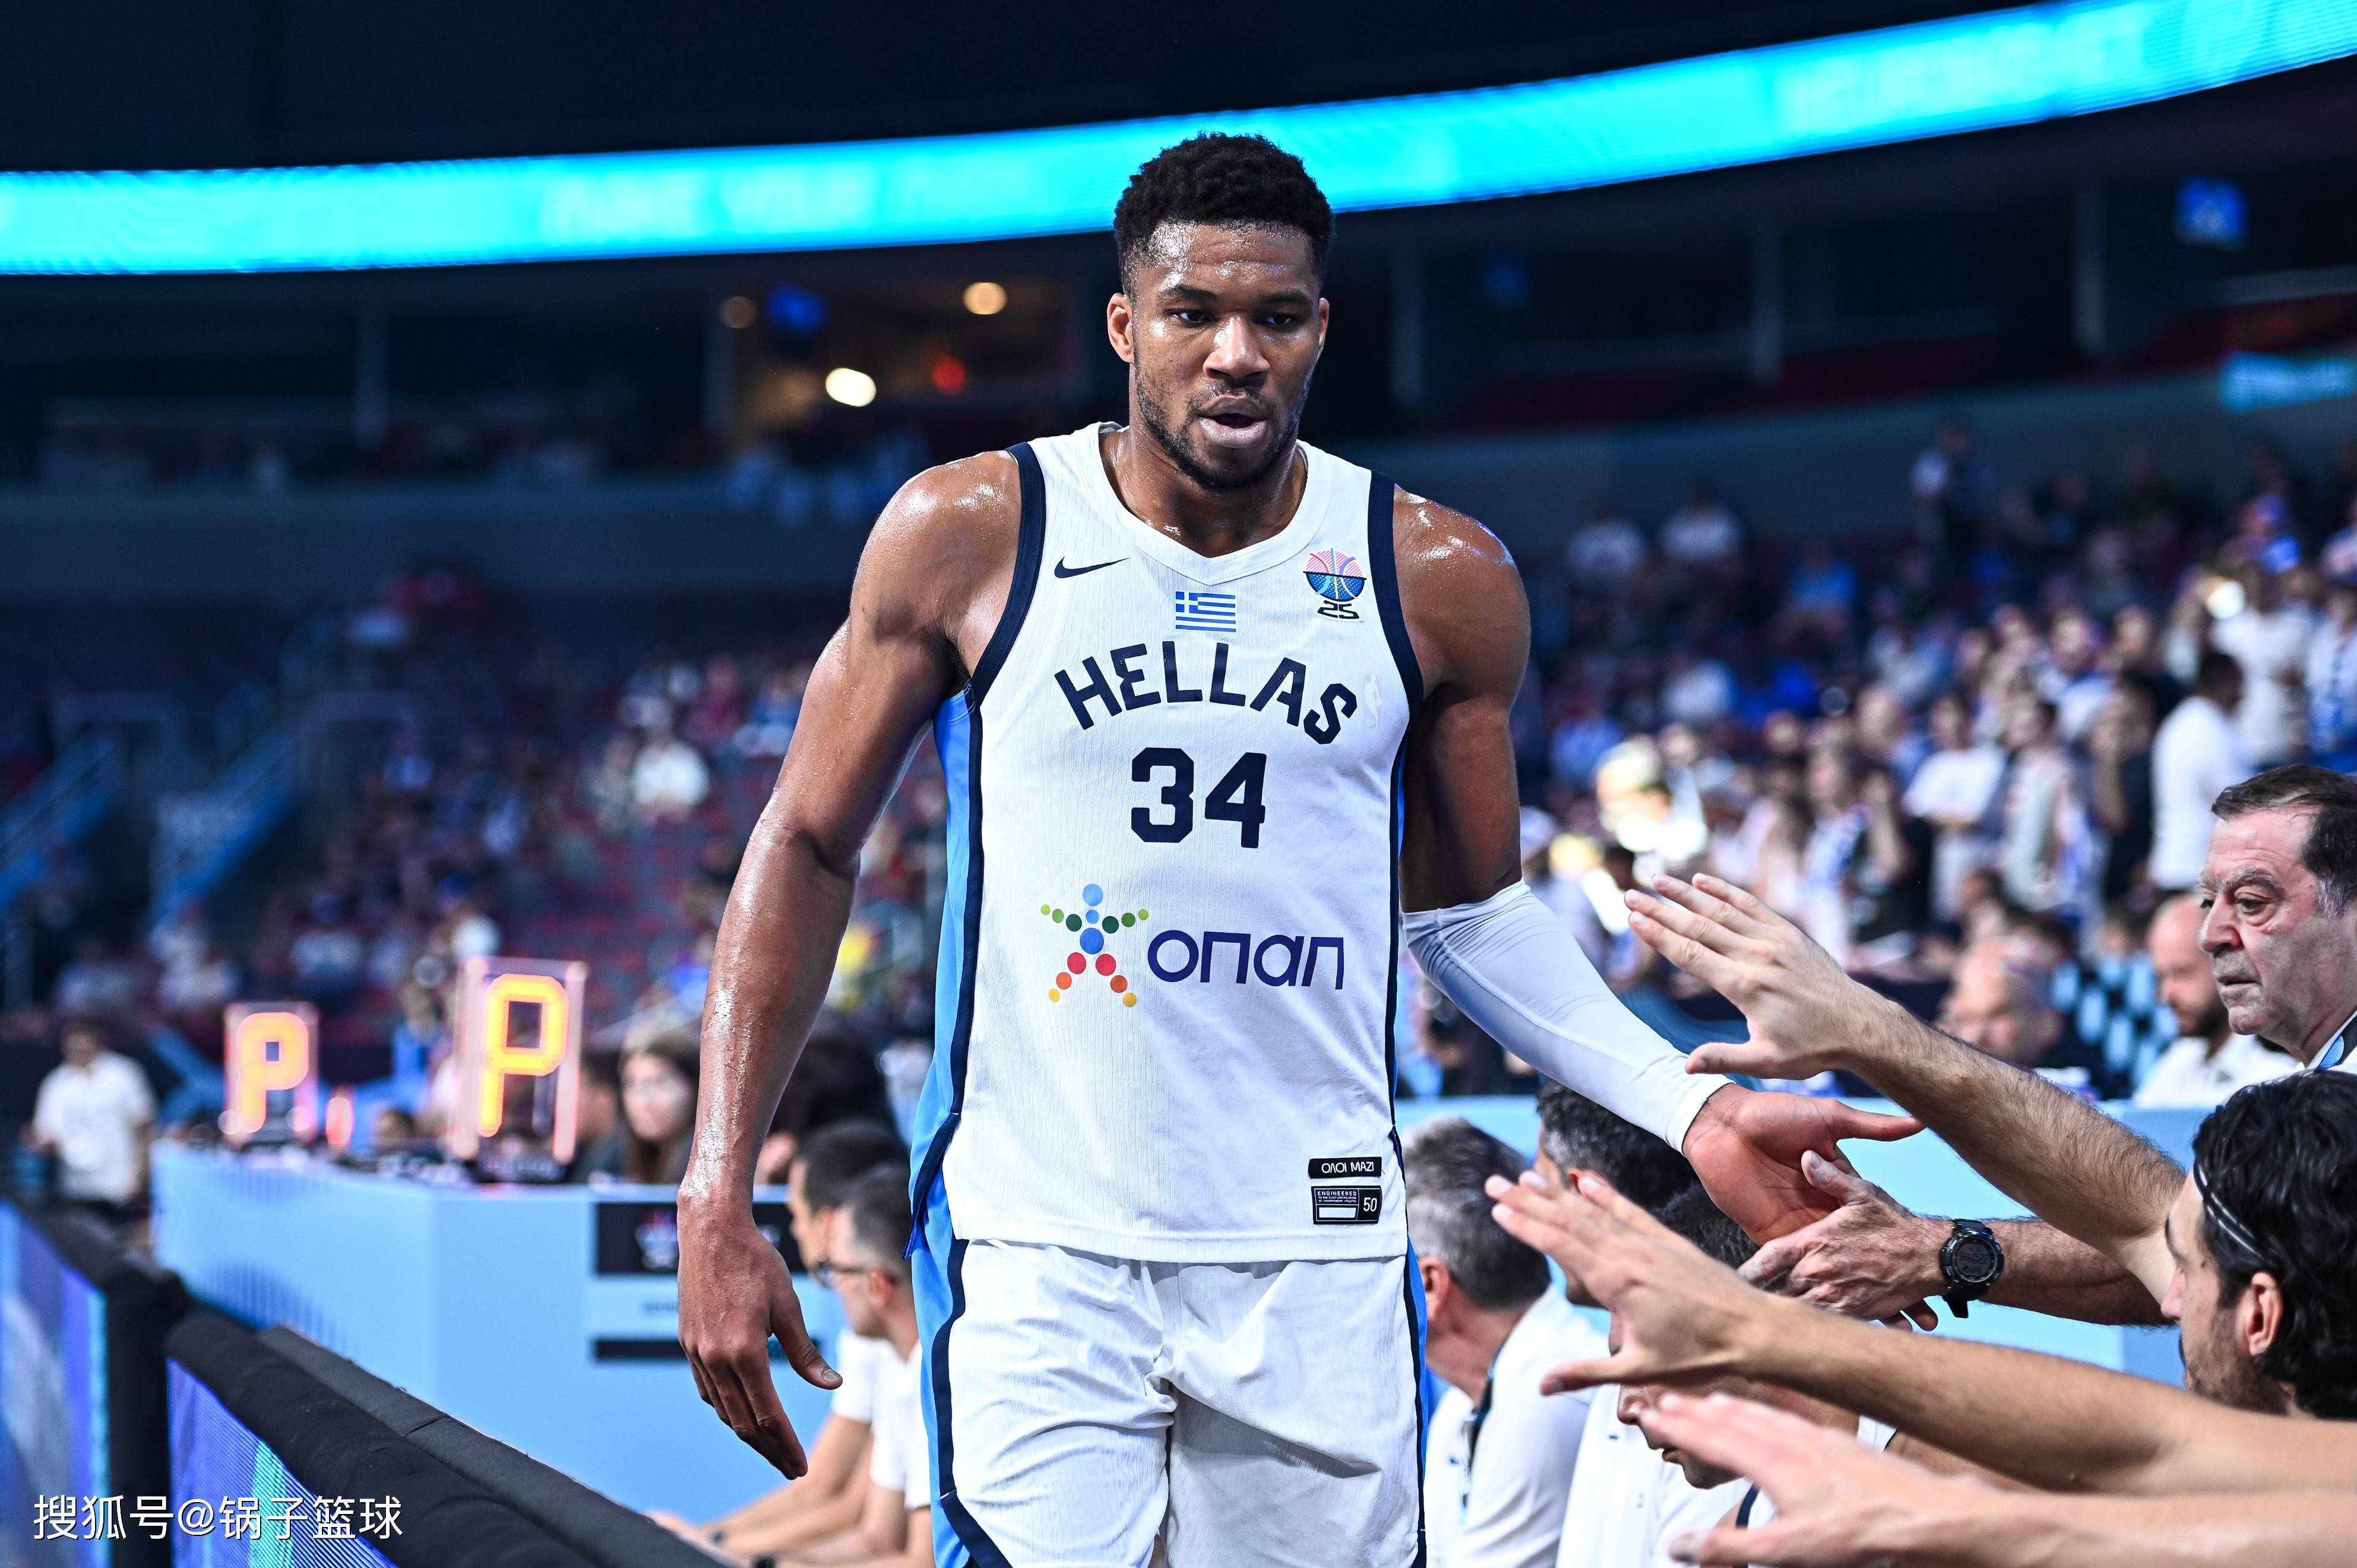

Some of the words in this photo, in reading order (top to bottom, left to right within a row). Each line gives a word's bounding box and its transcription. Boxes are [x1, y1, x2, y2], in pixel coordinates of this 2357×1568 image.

[1054, 641, 1358, 745] HELLAS
[1131, 747, 1267, 849] 34
[477, 973, 569, 1137] P
[1363, 1197, 1377, 1212] 50
